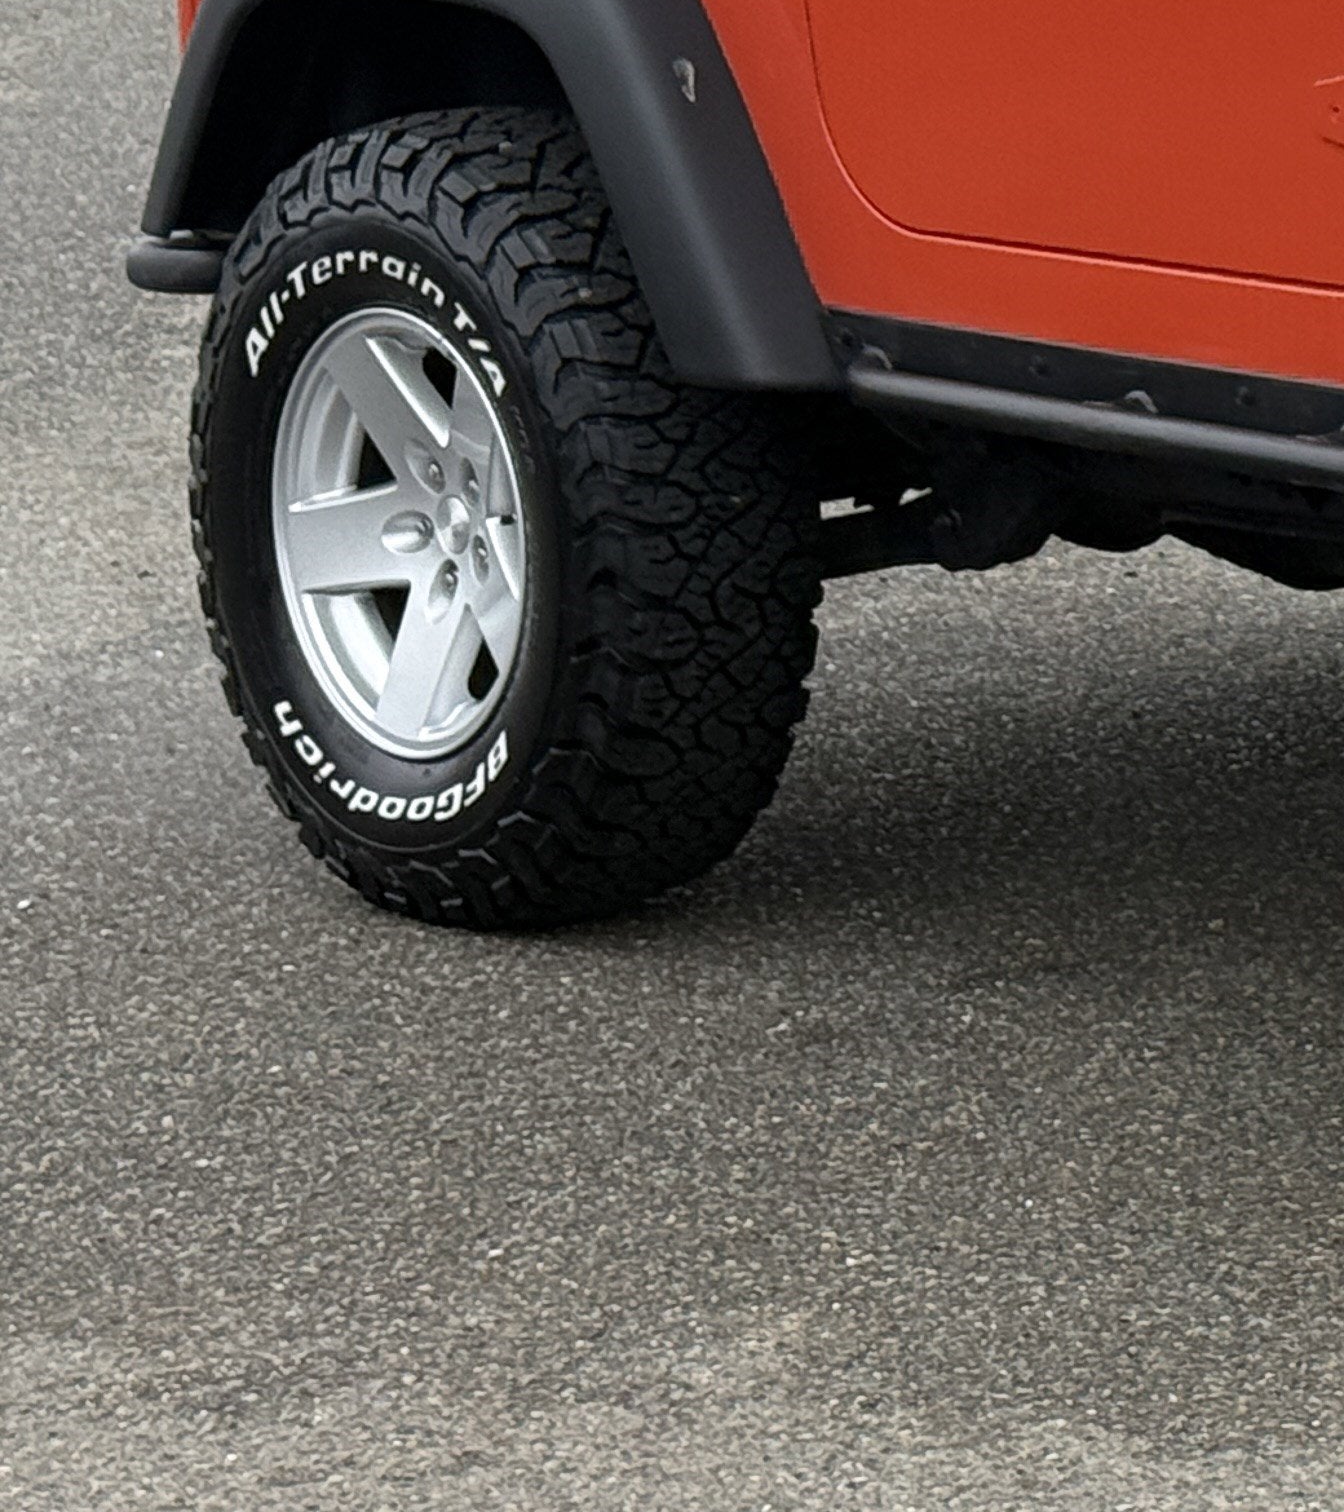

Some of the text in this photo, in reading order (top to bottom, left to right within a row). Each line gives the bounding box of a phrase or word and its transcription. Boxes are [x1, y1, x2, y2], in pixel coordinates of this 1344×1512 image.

[242, 247, 508, 398] All-Terrain T/A
[273, 698, 510, 824] BFGoodrich
